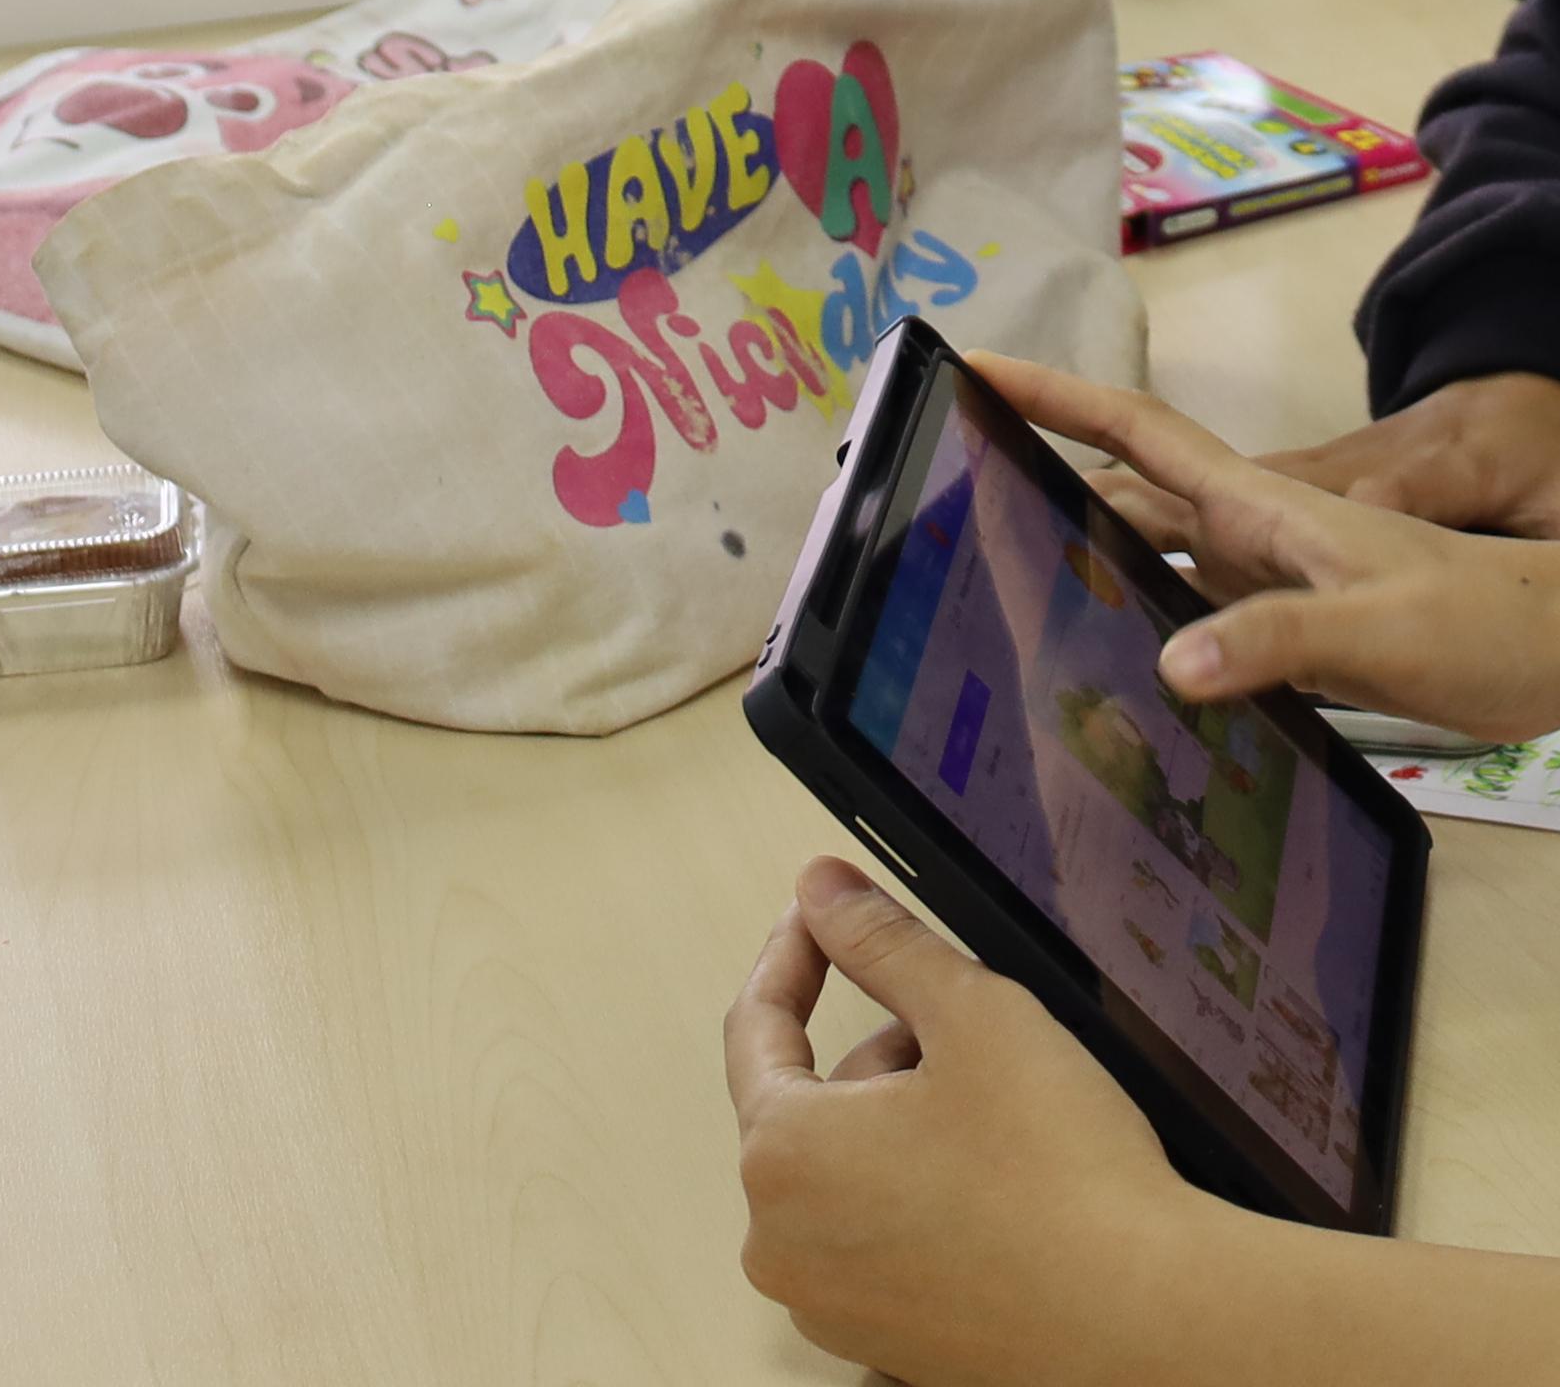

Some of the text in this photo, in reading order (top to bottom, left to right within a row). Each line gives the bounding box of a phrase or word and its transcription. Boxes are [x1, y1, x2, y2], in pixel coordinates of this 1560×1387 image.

[524, 72, 893, 297] HAVE A
[820, 230, 978, 372] day
